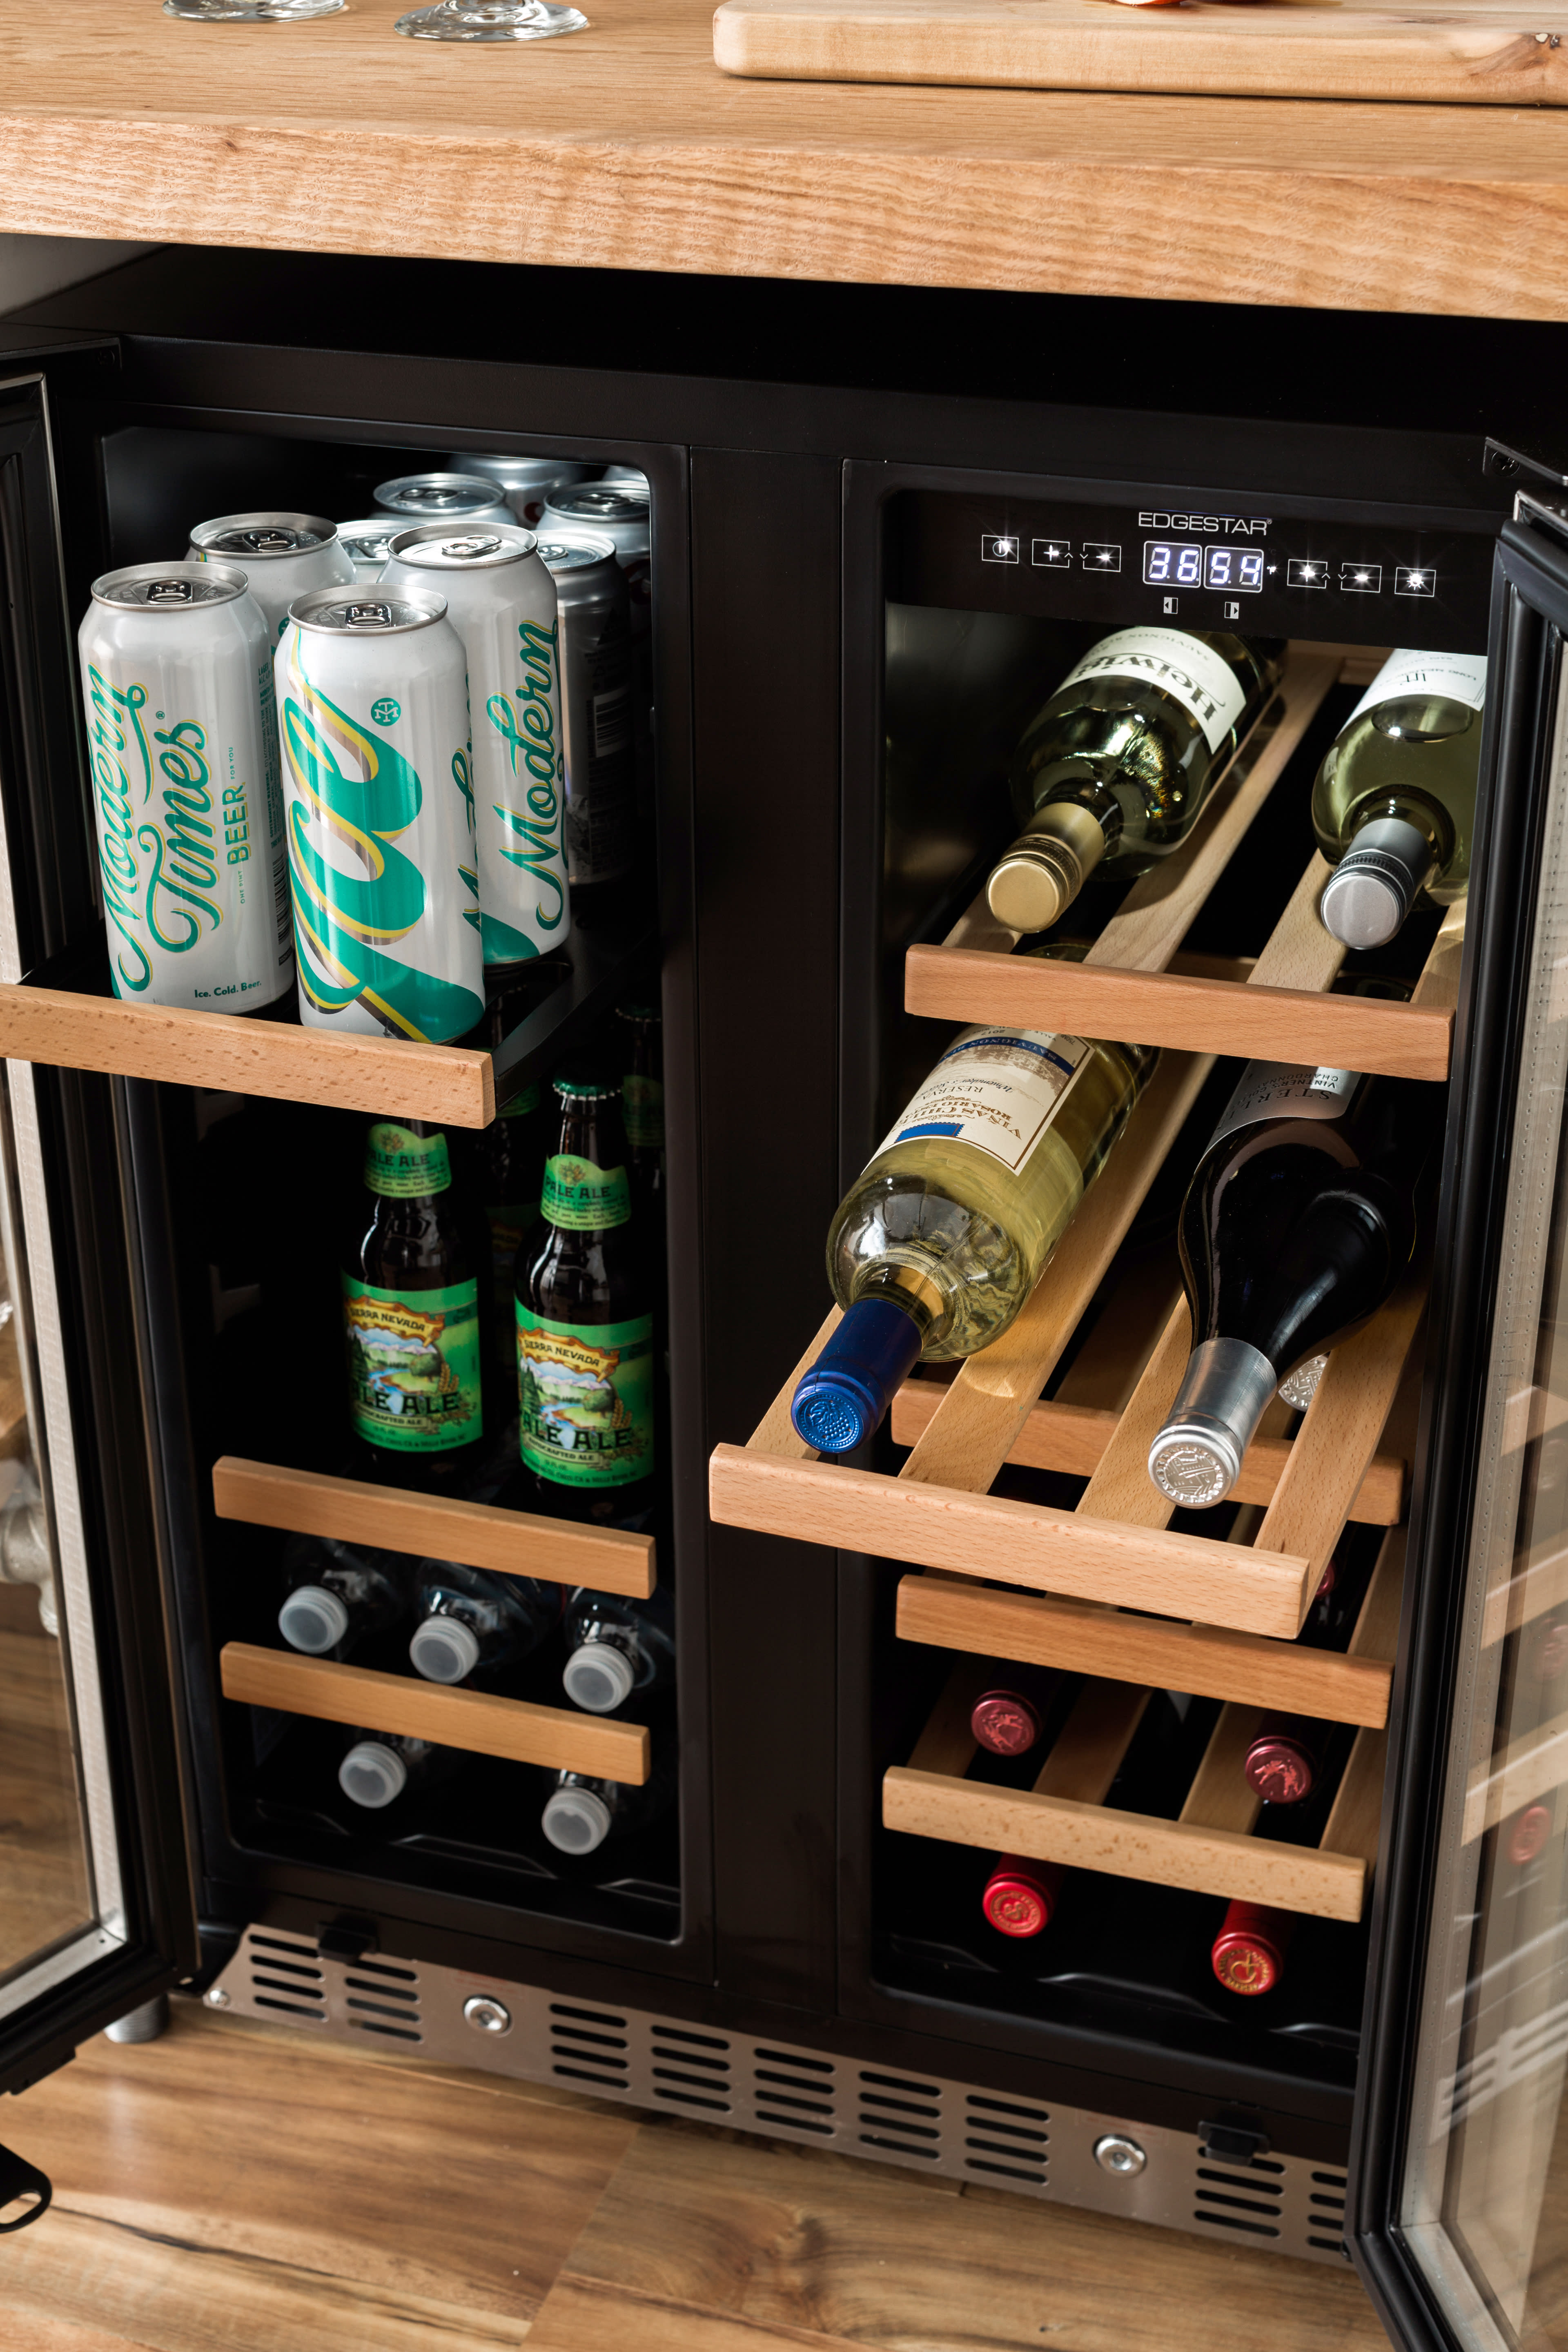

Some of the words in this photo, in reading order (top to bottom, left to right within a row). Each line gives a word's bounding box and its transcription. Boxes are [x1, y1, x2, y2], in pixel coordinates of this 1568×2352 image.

[1149, 547, 1199, 581] 36
[1209, 552, 1262, 585] 54
[486, 615, 564, 931] Modern
[88, 662, 154, 991] Modern
[222, 782, 252, 865] BEER
[194, 989, 212, 998] Ice.
[214, 984, 239, 996] Cold.
[241, 980, 262, 991] Beer.
[922, 1086, 983, 1100] RESERVA
[1271, 1079, 1336, 1089] VINTNER'S
[942, 1101, 1013, 1120] ROSARIO
[962, 1107, 1022, 1140] VIÑAS
[579, 1186, 611, 1199] ALE
[381, 1312, 425, 1332] NEVADA
[524, 1339, 553, 1352] SIERRA
[555, 1347, 600, 1367] NEVADA
[401, 1391, 459, 1415] ALE
[572, 1427, 632, 1450] ALE
